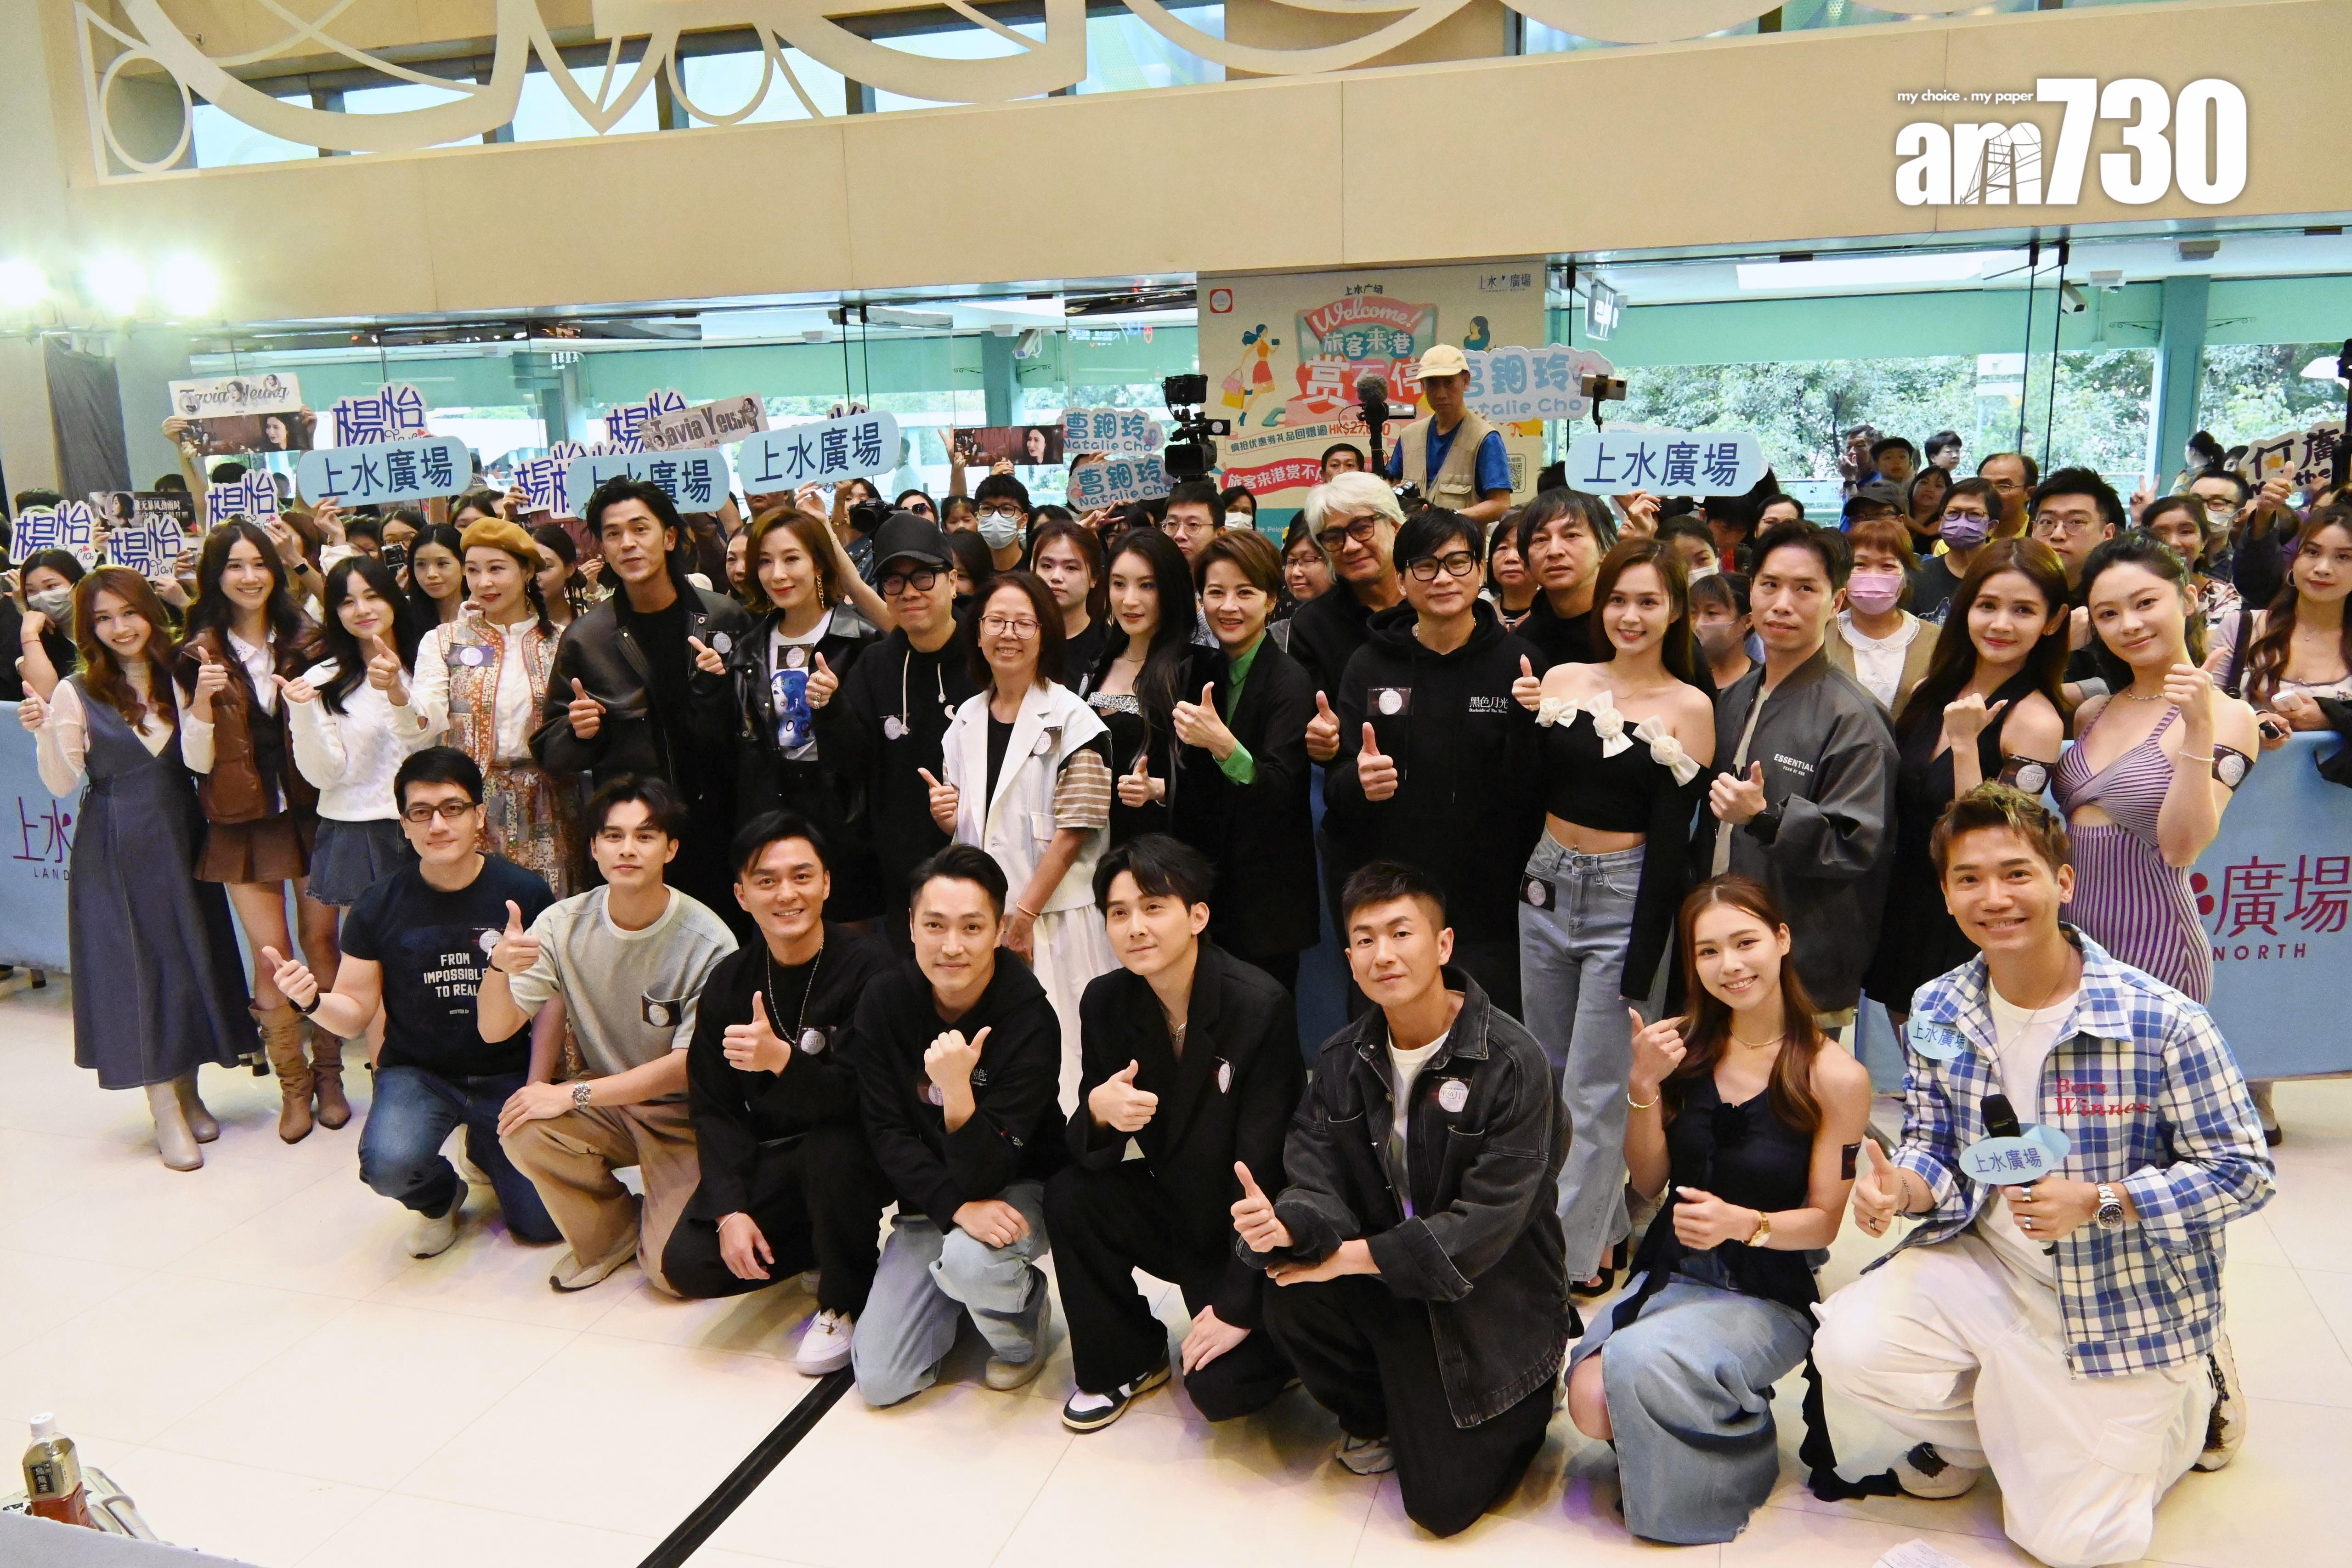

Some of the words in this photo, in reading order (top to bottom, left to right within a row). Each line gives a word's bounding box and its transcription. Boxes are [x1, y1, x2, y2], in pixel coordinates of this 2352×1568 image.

[1345, 284, 1383, 295] 上水广场
[1312, 294, 1424, 332] Welcome!
[1322, 325, 1411, 357] 旅客来港
[1466, 400, 1531, 414] talie
[1538, 398, 1582, 412] Cho
[333, 386, 424, 447] 楊怡
[1329, 420, 1391, 436] HK$27,0
[755, 421, 882, 482] 上水廣場
[1063, 439, 1119, 451] Natalie
[1124, 441, 1152, 452] Cho
[318, 446, 453, 498] 上水廣場
[1583, 441, 1741, 487] 上水廣場
[1080, 490, 1138, 506] Natalie
[1142, 484, 1172, 496] Cho
[1469, 696, 1509, 709] 黑色月光
[1774, 753, 1814, 772] ESSENTIAL
[2213, 855, 2351, 938] 廣場
[441, 952, 470, 967] FROM
[2213, 943, 2307, 961] NORTH
[435, 985, 450, 998] TO
[453, 984, 477, 996] REAL
[1913, 1022, 1965, 1050] 上水廣場
[2054, 1078, 2108, 1094] Born
[2054, 1097, 2152, 1116] Winner
[1975, 1148, 2042, 1174] 上水廣場
